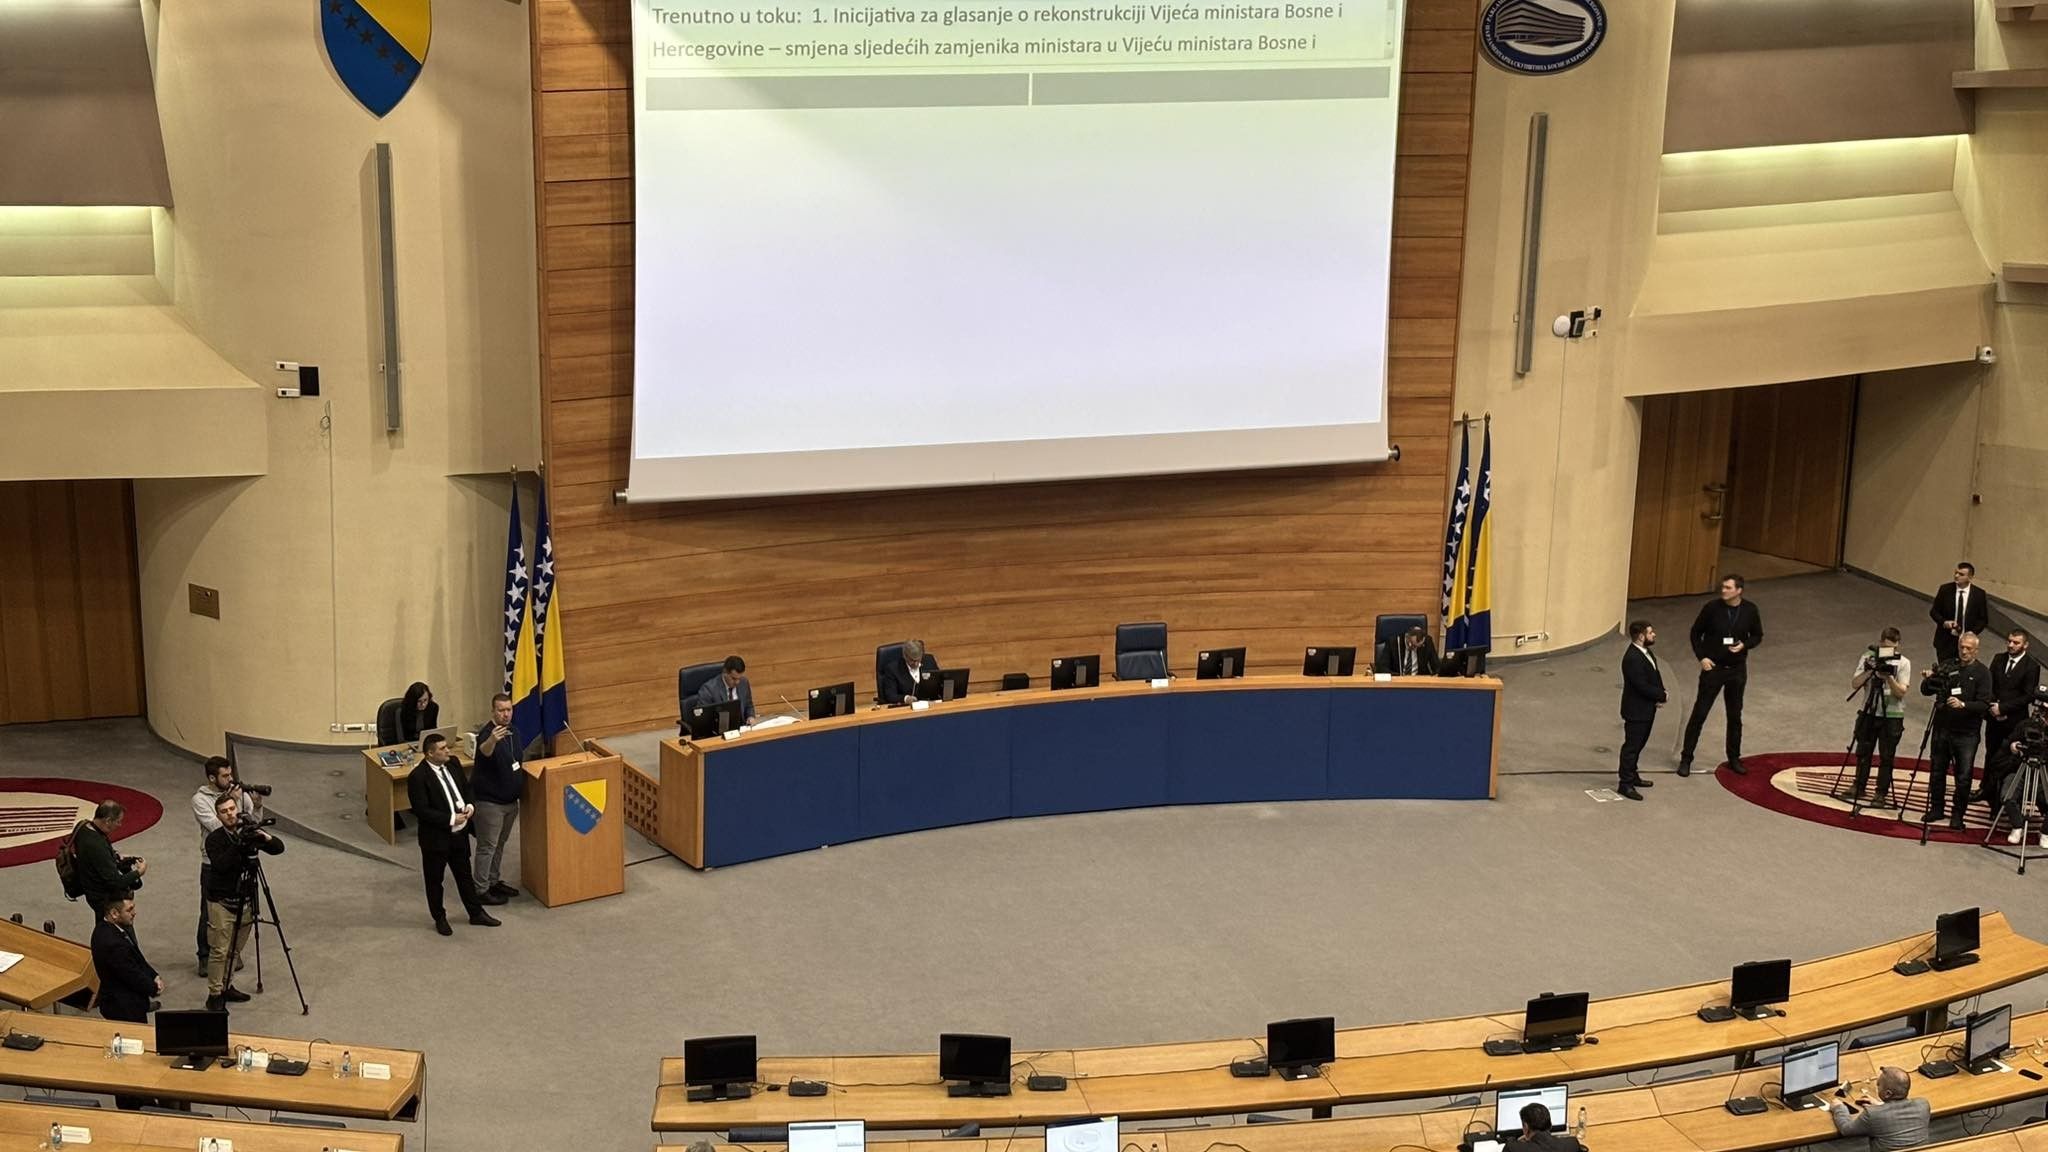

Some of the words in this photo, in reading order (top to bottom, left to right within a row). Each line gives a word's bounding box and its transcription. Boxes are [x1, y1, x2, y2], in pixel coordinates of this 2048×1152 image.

[652, 8, 735, 25] Trenutno
[740, 11, 750, 24] u
[757, 8, 801, 24] toku:
[812, 8, 828, 23] 1.
[834, 7, 916, 27] Inicijativa
[920, 10, 938, 23] za
[943, 6, 1013, 26] glasanje
[1018, 9, 1028, 22] o
[1034, 5, 1146, 25] rekonstrukciji
[1151, 5, 1199, 24] Vijeća
[1204, 4, 1279, 20] ministara
[1285, 4, 1334, 19] Bosne
[1339, 3, 1343, 17] i
[653, 41, 764, 60] Hercegovine
[785, 41, 848, 59] smjena
[854, 39, 929, 59] sljedećih
[935, 37, 1019, 57] zamjenika
[1025, 37, 1100, 53] ministara
[1108, 40, 1117, 53] u
[1122, 36, 1172, 55] Vijeću
[1178, 36, 1252, 51] ministara
[1259, 35, 1307, 50] Bosne
[1312, 35, 1317, 50] i
